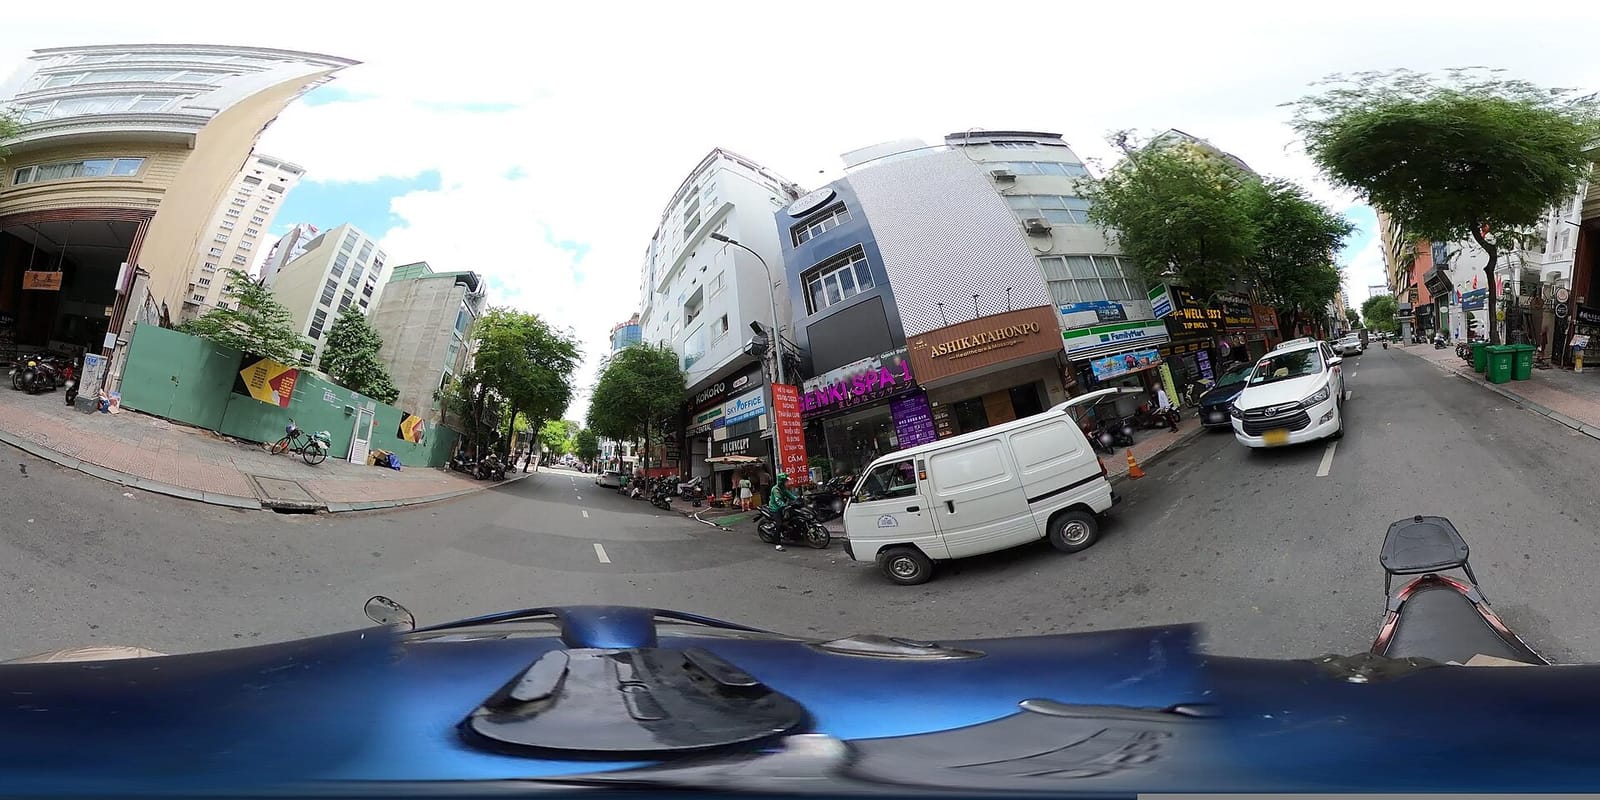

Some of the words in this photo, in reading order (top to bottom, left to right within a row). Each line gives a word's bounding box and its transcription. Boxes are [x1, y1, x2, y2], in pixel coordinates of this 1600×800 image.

[931, 321, 1040, 358] ASHIKATAHONPO
[1111, 329, 1146, 341] FamilyMart
[852, 366, 896, 396] SPA
[900, 359, 913, 382] 1
[726, 406, 736, 416] SKY
[740, 395, 762, 410] OFFICE
[838, 381, 912, 409] まじめなマッサージ
[787, 453, 803, 463] CẤM
[797, 465, 807, 473] XE
